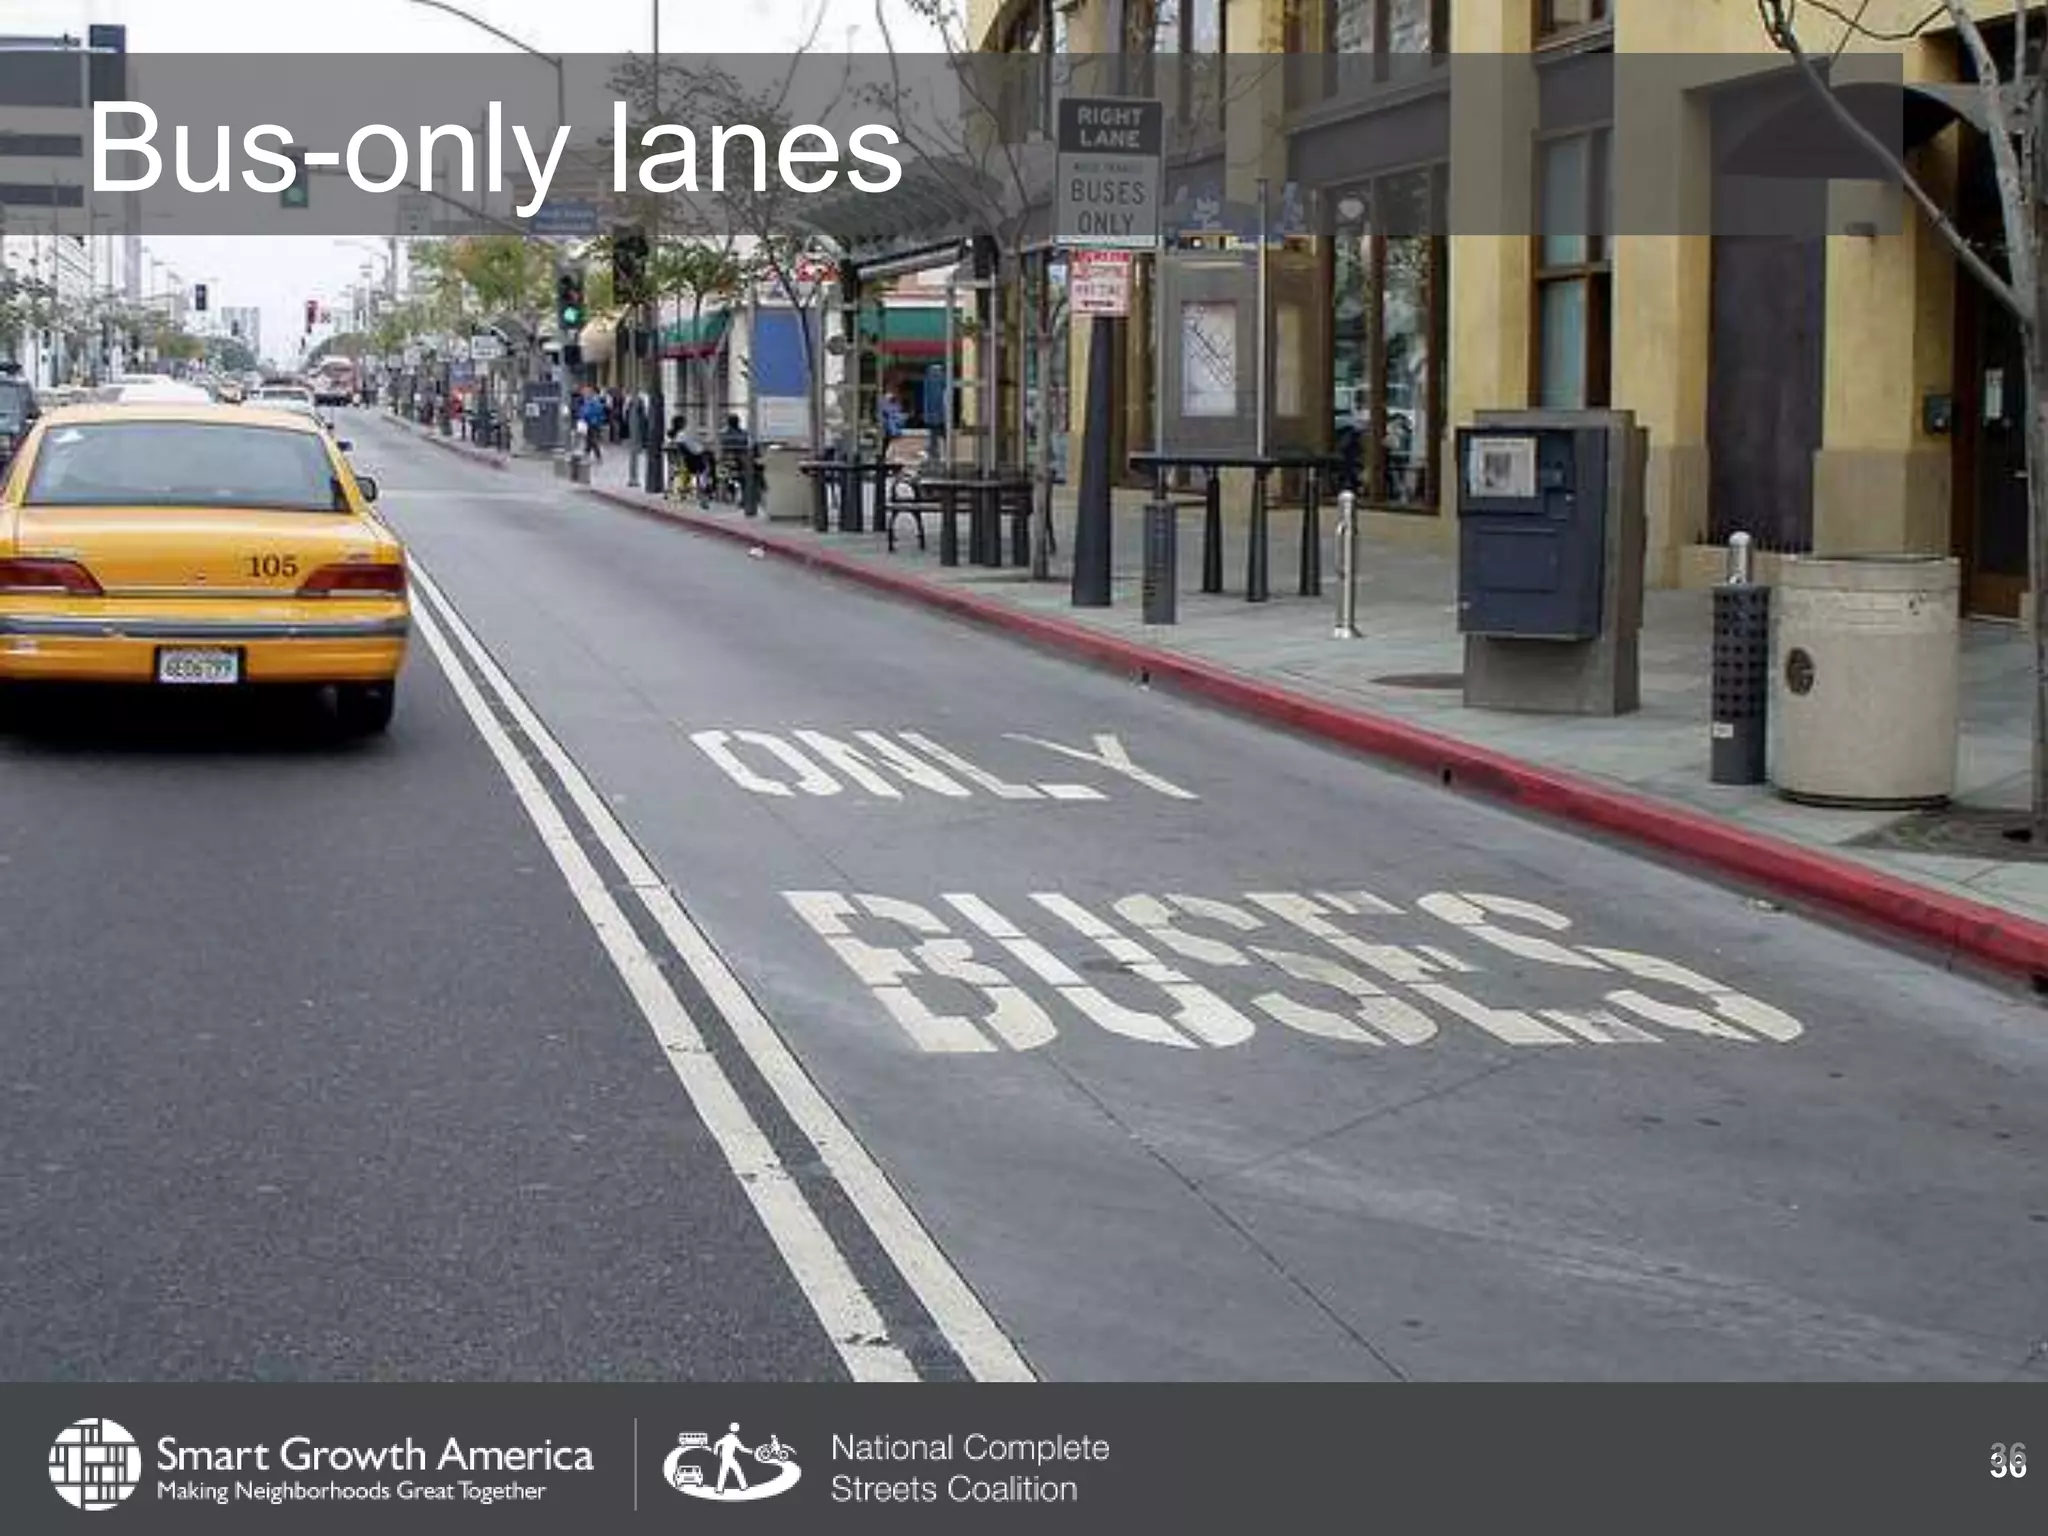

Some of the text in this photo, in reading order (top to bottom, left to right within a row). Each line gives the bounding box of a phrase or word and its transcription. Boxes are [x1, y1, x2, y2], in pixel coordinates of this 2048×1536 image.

[1078, 105, 1143, 126] RIGHT
[1080, 129, 1140, 148] LANE
[1070, 178, 1146, 206] BUSES
[1077, 210, 1135, 236] ONLY
[243, 553, 299, 577] 105
[690, 730, 1200, 799] ONLY
[780, 891, 1804, 1052] BUSES
